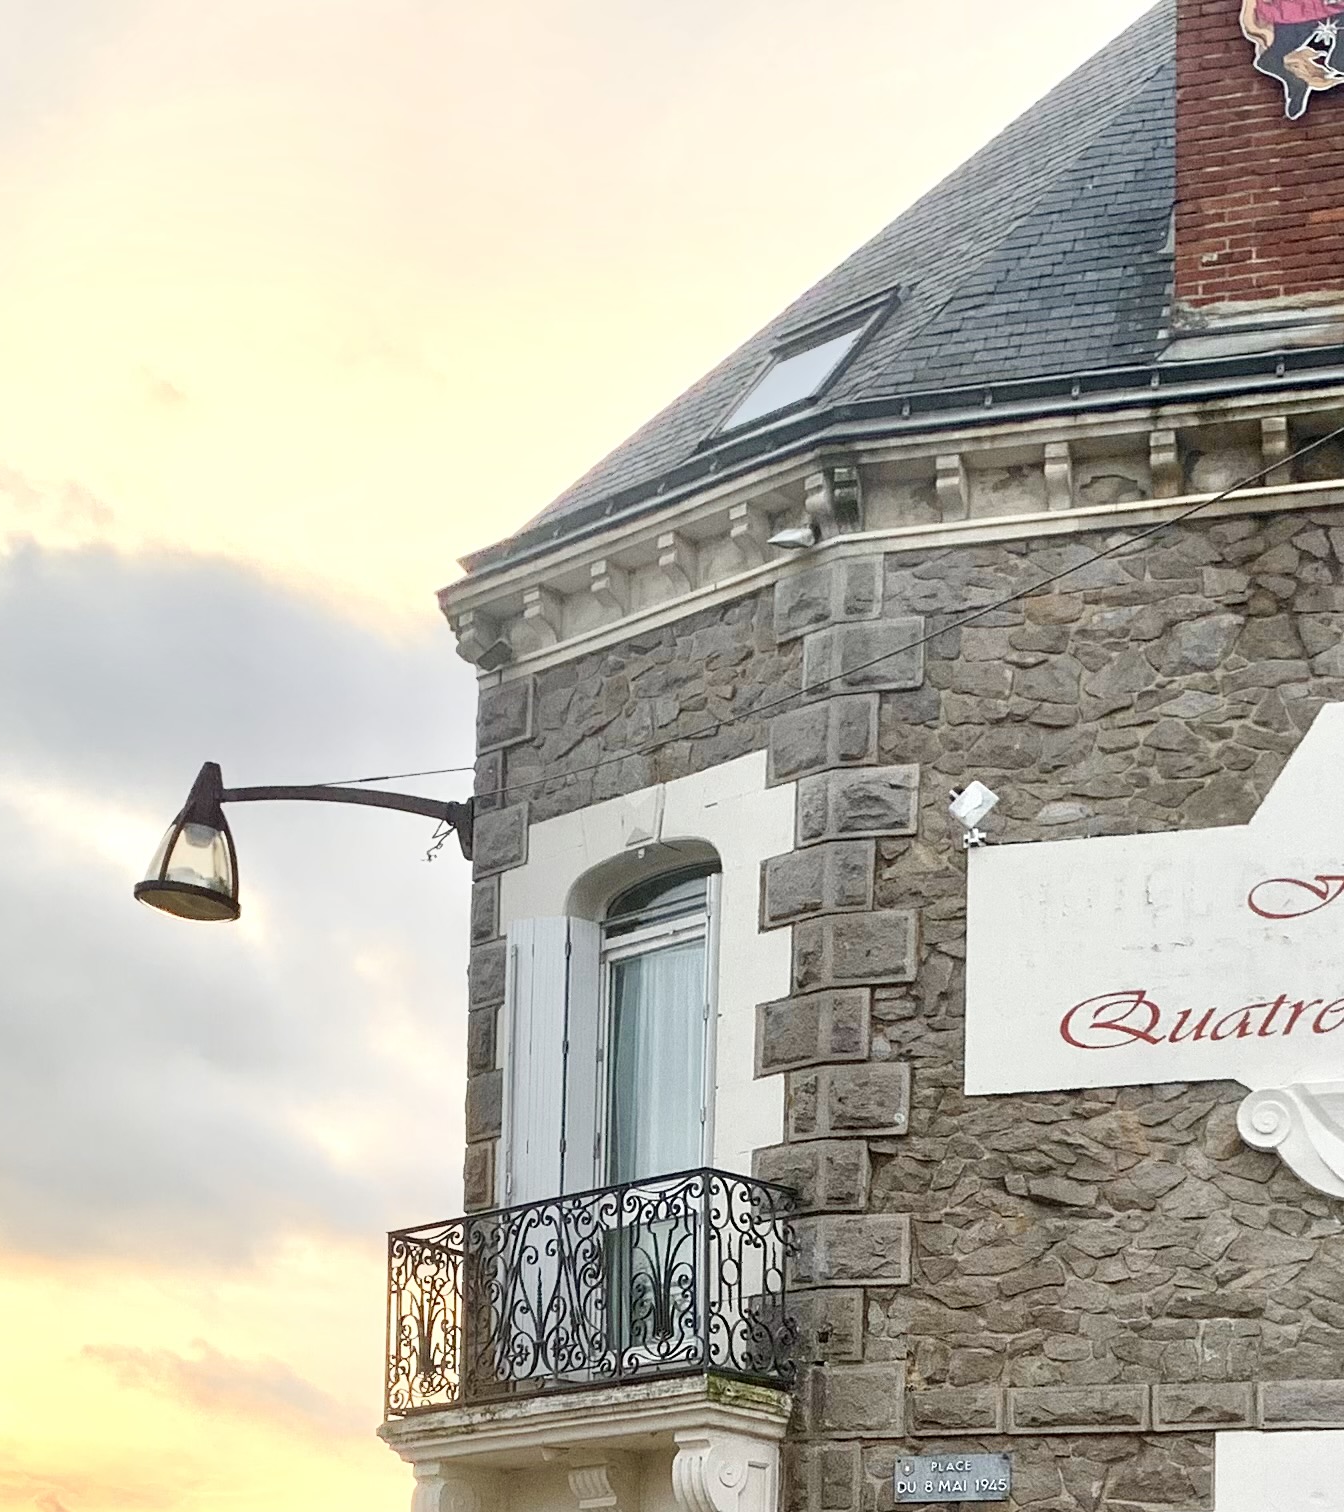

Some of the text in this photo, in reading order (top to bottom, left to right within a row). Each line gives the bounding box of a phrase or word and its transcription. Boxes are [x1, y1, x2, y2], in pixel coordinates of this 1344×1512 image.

[931, 1460, 972, 1472] PLACE
[897, 1479, 1007, 1493] DU 8 MAI 1945
